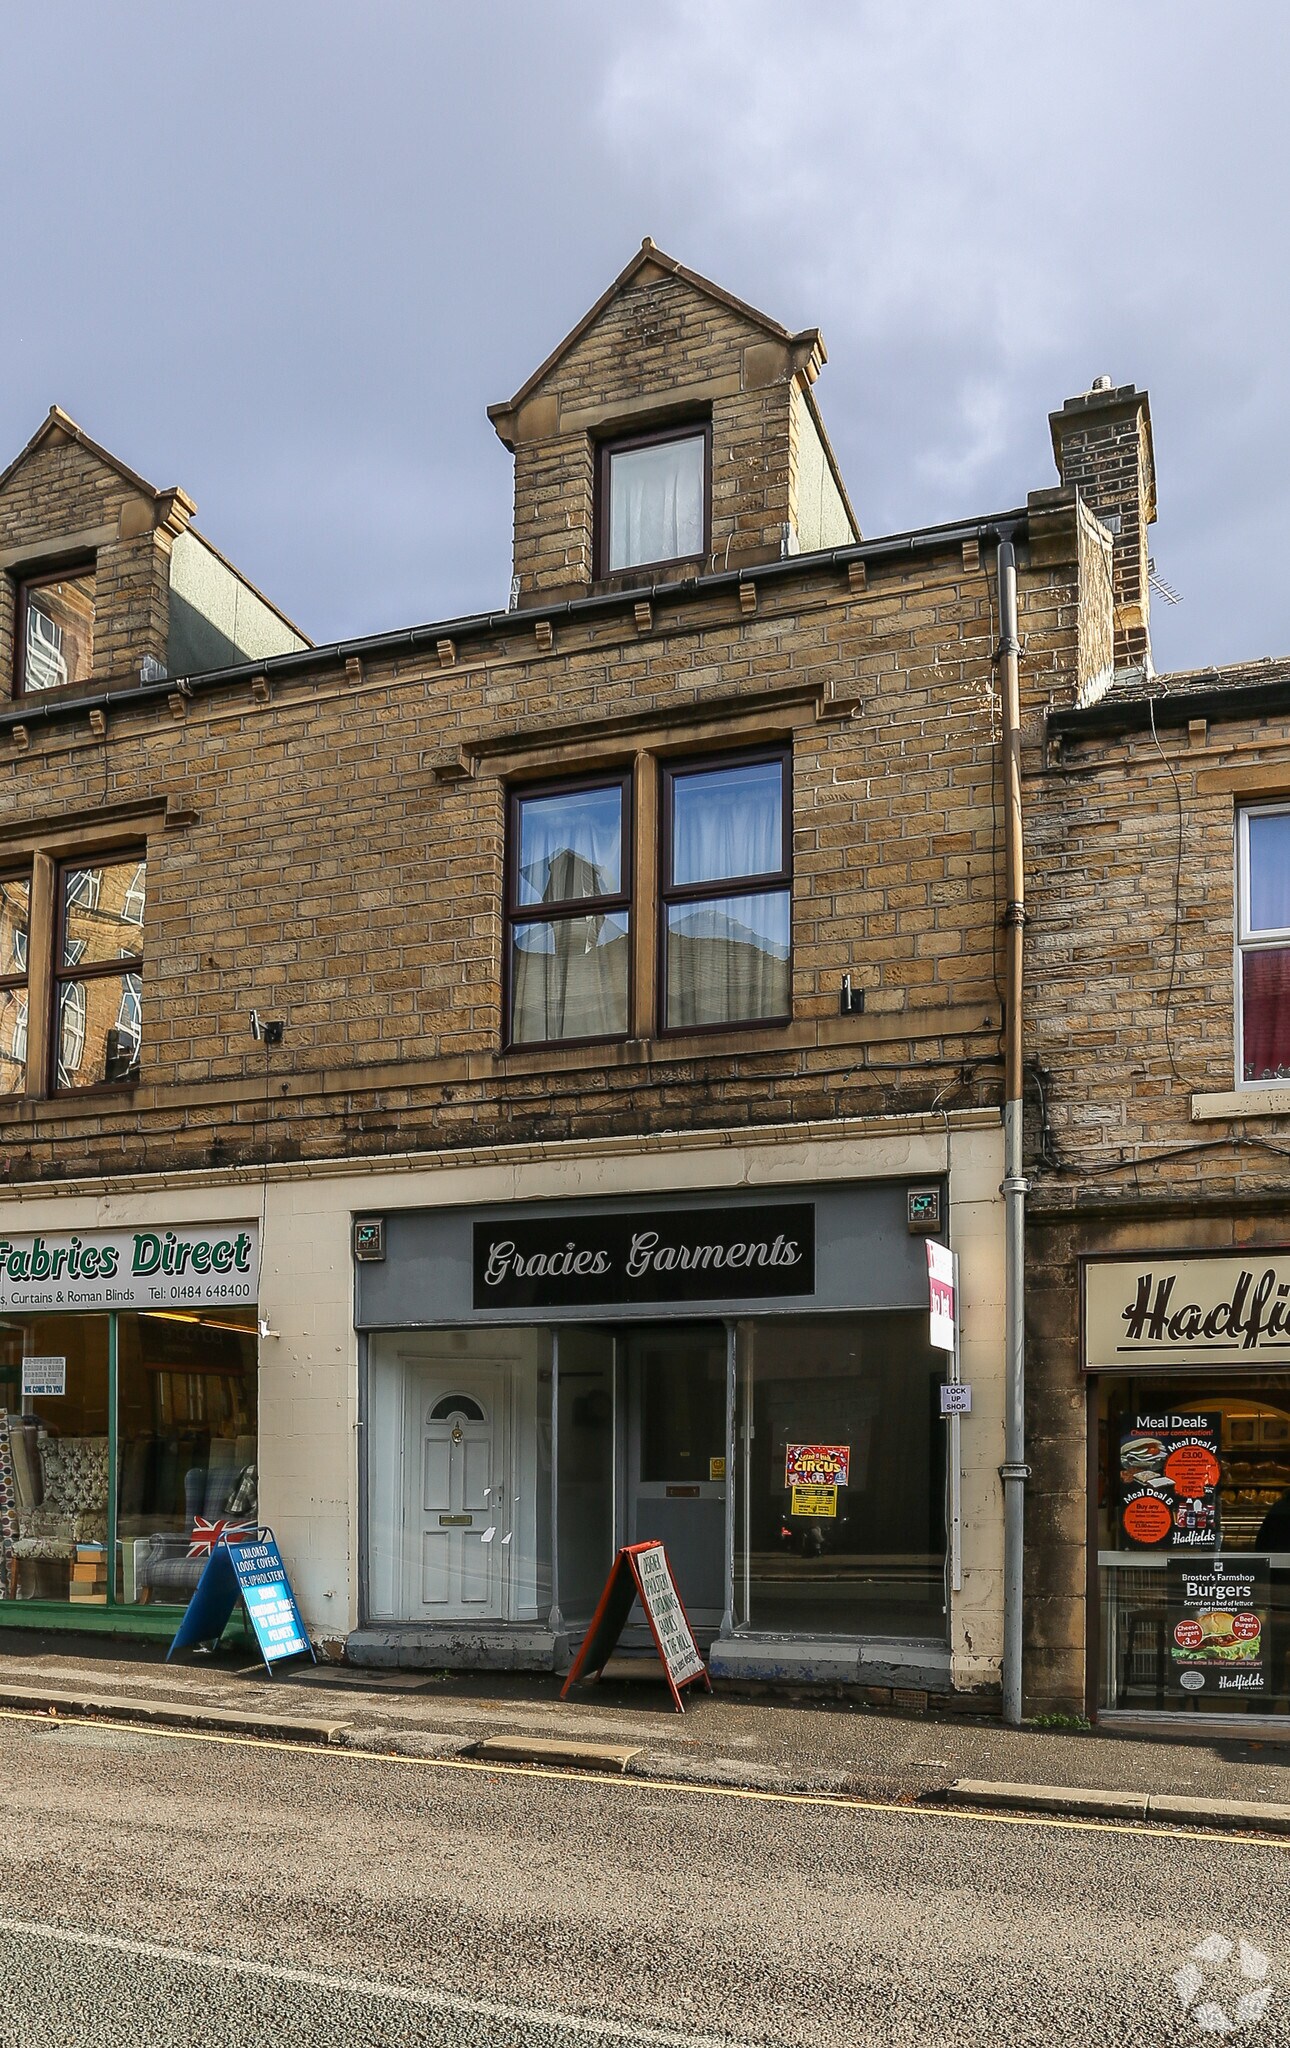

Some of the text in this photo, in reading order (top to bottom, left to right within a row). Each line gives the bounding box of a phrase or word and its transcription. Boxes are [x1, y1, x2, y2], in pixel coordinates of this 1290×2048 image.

[0, 1231, 252, 1281] Fabrics Direct
[485, 1231, 802, 1285] Gracies Garments
[11, 1292, 53, 1304] Curtains
[56, 1292, 64, 1303] &
[67, 1291, 101, 1302] Roman
[105, 1288, 135, 1301] Blinds
[148, 1286, 166, 1300] Tel:
[170, 1285, 201, 1299] 01484
[205, 1283, 250, 1298] 648400
[1121, 1269, 1290, 1350] Hadfi
[53, 1385, 62, 1394] YOU
[1136, 1415, 1208, 1428] Meal Deals
[1167, 1437, 1218, 1454] Meal Deal A
[794, 1460, 841, 1473] CIRCUS
[1123, 1488, 1145, 1504] Meal
[1146, 1488, 1168, 1502] Deal
[1172, 1529, 1215, 1545] Hadfields
[239, 1545, 269, 1560] TAILORED
[236, 1555, 279, 1573] LOOSE COVERS
[240, 1570, 285, 1587] RE-UPHOLSTERY
[1182, 1573, 1255, 1582] Broster's Farmshop
[1186, 1582, 1251, 1600] Burgers
[1219, 1673, 1265, 1690] Hadfields
